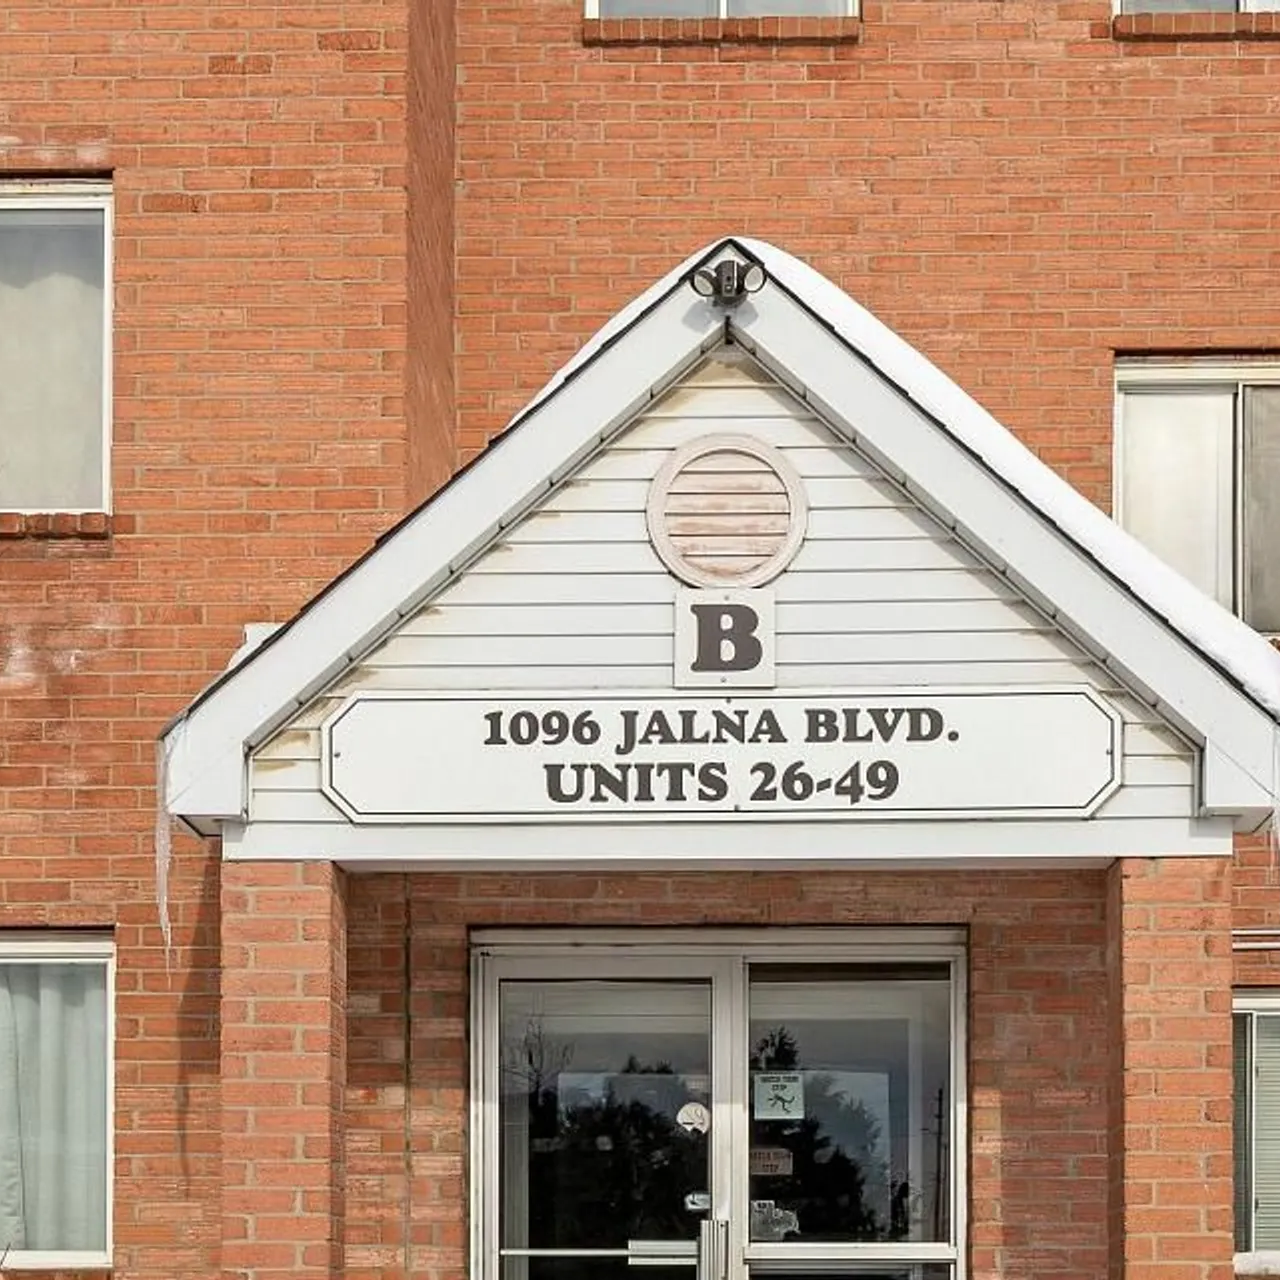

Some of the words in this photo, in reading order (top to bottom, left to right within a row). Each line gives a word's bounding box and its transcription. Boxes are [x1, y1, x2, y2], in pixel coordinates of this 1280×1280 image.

[690, 603, 763, 673] B
[482, 710, 601, 746] 1096
[615, 708, 788, 756] JALNA
[805, 707, 960, 743] BLVD.
[543, 762, 729, 803] UNITS
[749, 760, 899, 806] 26-49
